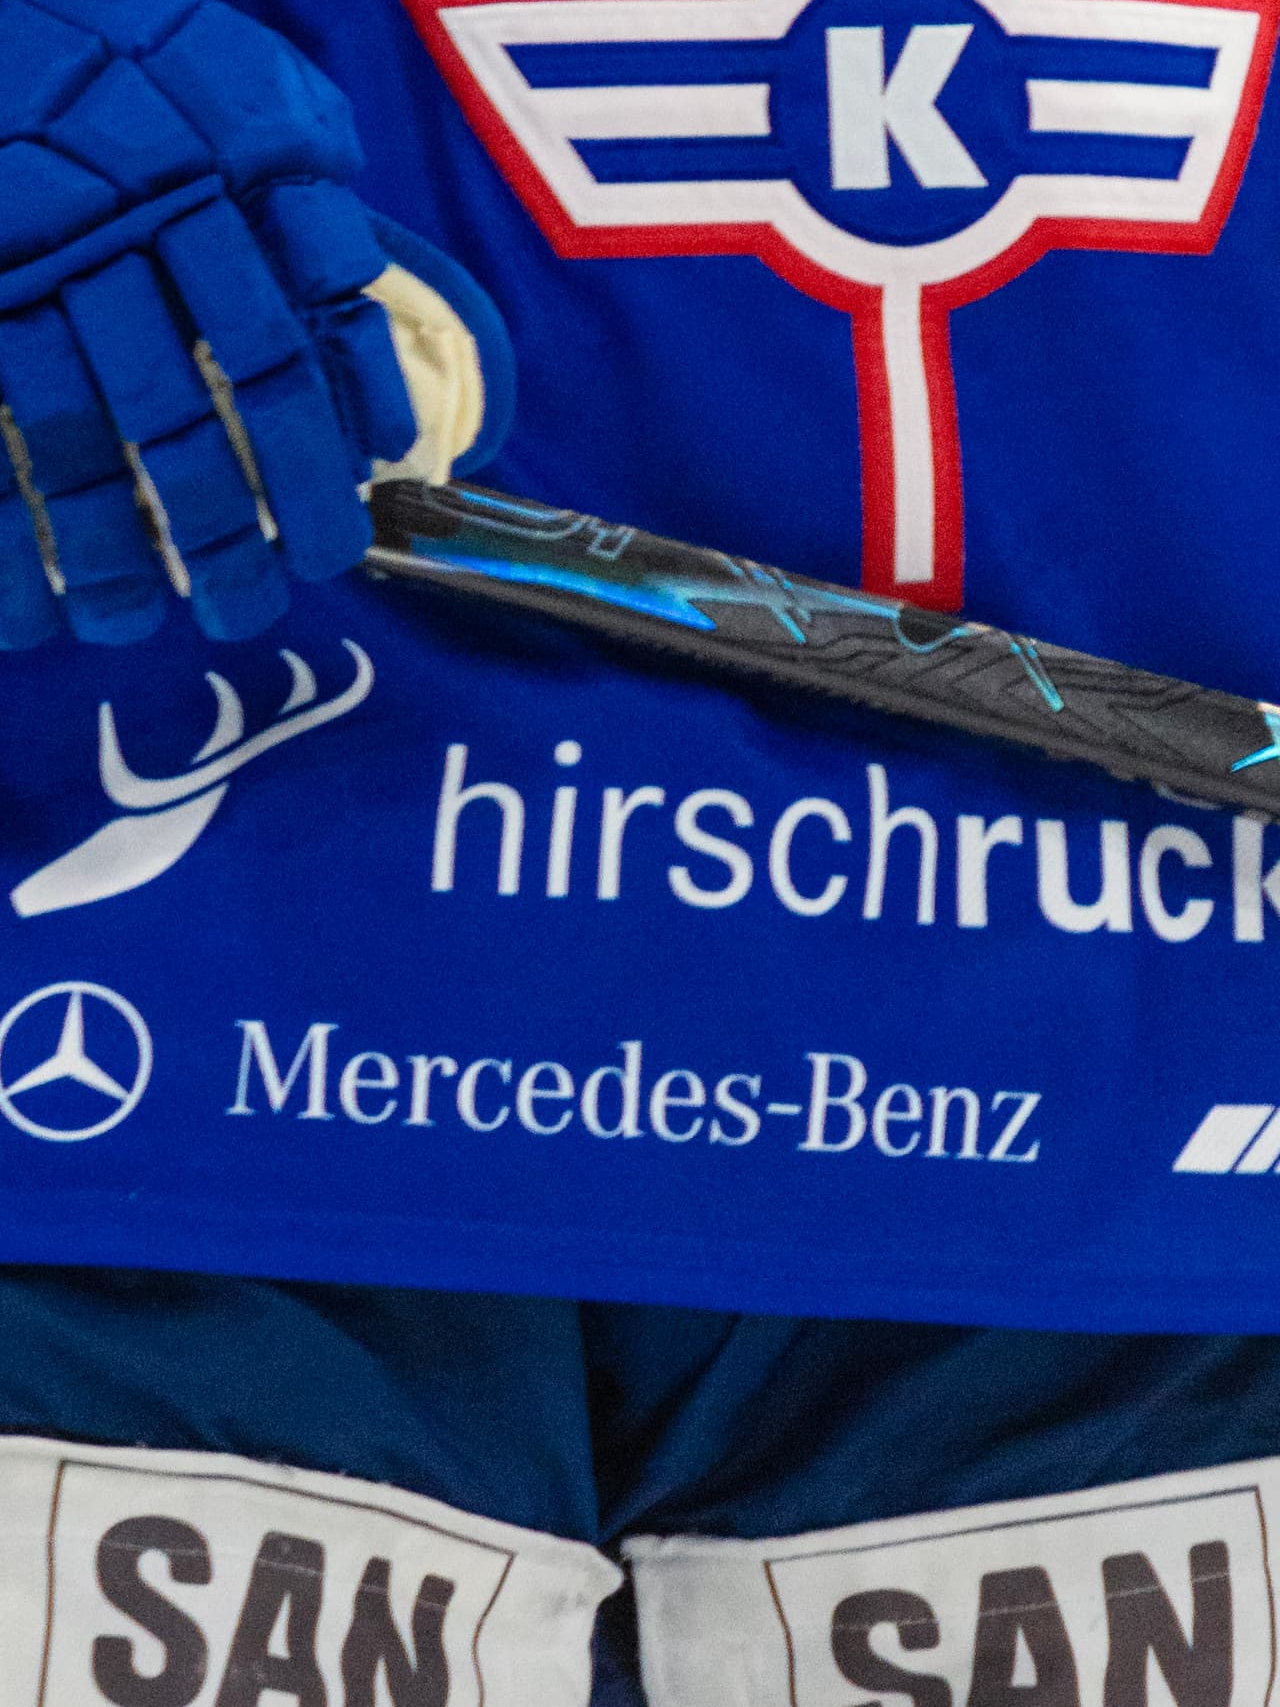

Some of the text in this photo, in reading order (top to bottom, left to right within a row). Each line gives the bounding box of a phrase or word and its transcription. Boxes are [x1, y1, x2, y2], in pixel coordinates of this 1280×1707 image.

[825, 23, 989, 191] K
[224, 1018, 1042, 1164] Mercedes-Benz
[91, 1513, 456, 1707] SAN
[830, 1538, 1233, 1707] SAN
